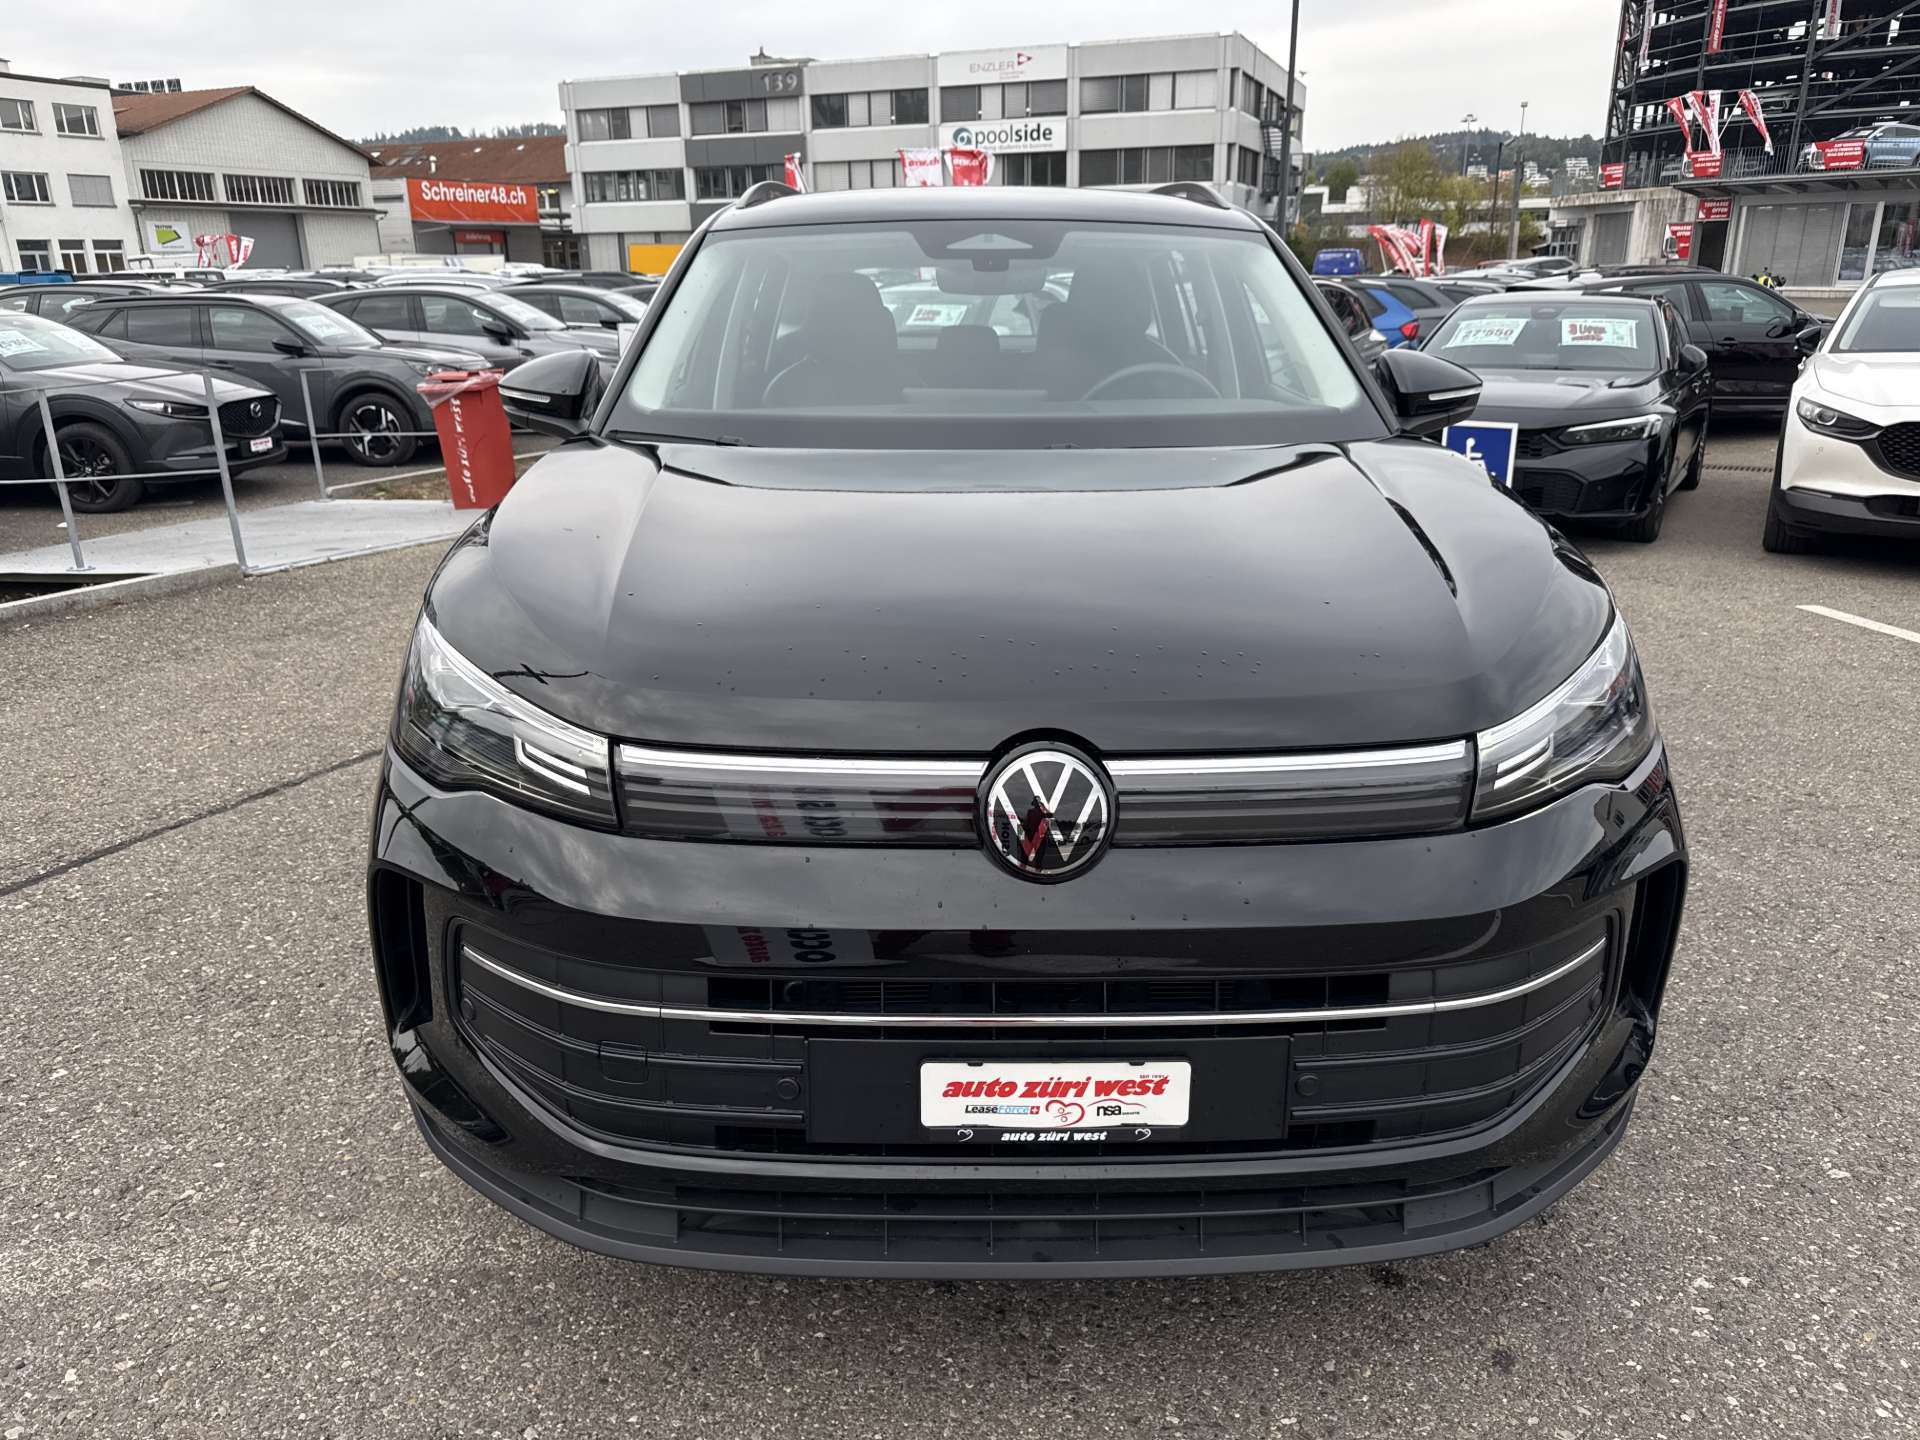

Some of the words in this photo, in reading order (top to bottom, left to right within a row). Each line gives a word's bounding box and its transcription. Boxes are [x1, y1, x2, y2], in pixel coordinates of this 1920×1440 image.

[969, 60, 1015, 73] ENZLER
[761, 72, 798, 92] 139
[975, 123, 1053, 148] poolside
[421, 180, 527, 205] Schreiner48.ch
[942, 1077, 1018, 1098] auto
[1019, 1075, 1092, 1099] züri
[1094, 1075, 1170, 1097] west
[965, 1104, 1029, 1115] LeaseForce
[1096, 1105, 1122, 1117] nsa
[1001, 1131, 1036, 1142] auto
[1037, 1130, 1071, 1142] züri
[1073, 1131, 1108, 1141] west
